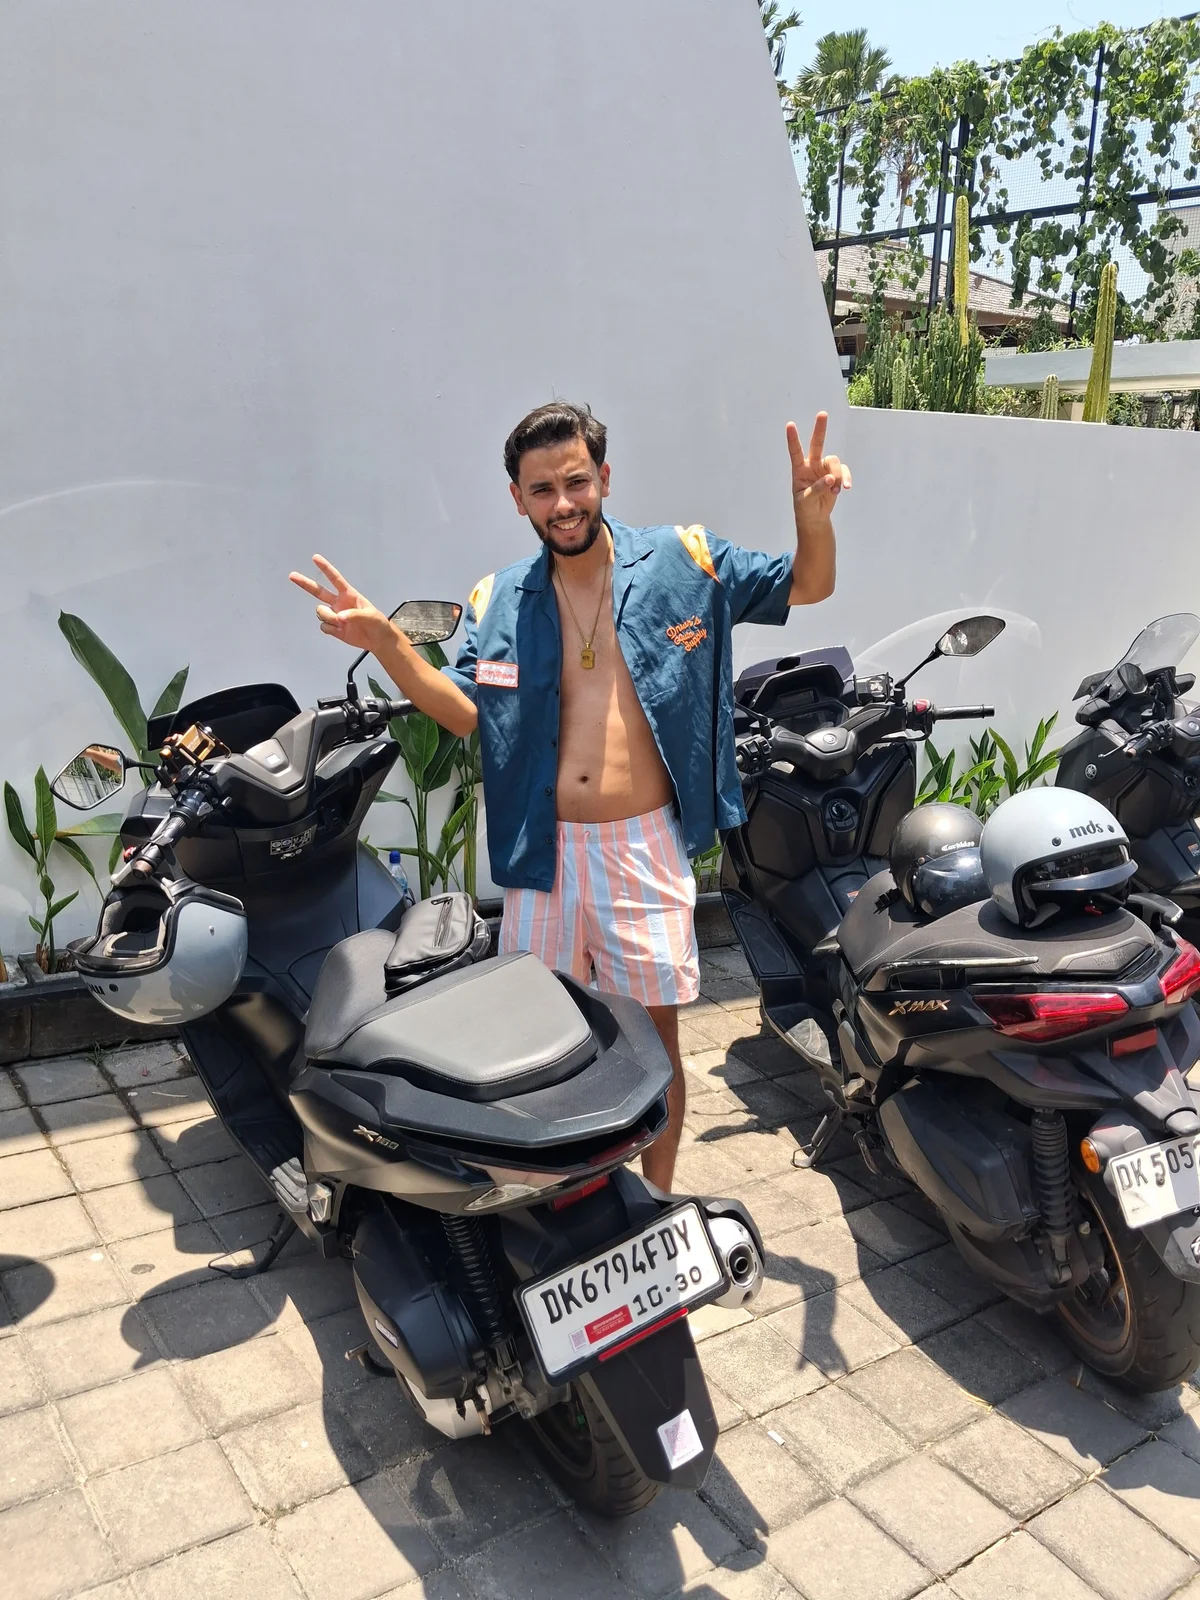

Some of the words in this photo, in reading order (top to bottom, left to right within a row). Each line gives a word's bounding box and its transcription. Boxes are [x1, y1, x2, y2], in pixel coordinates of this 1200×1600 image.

[1068, 819, 1104, 839] mds
[888, 999, 951, 1016] XMAX
[1115, 1157, 1149, 1192] DK
